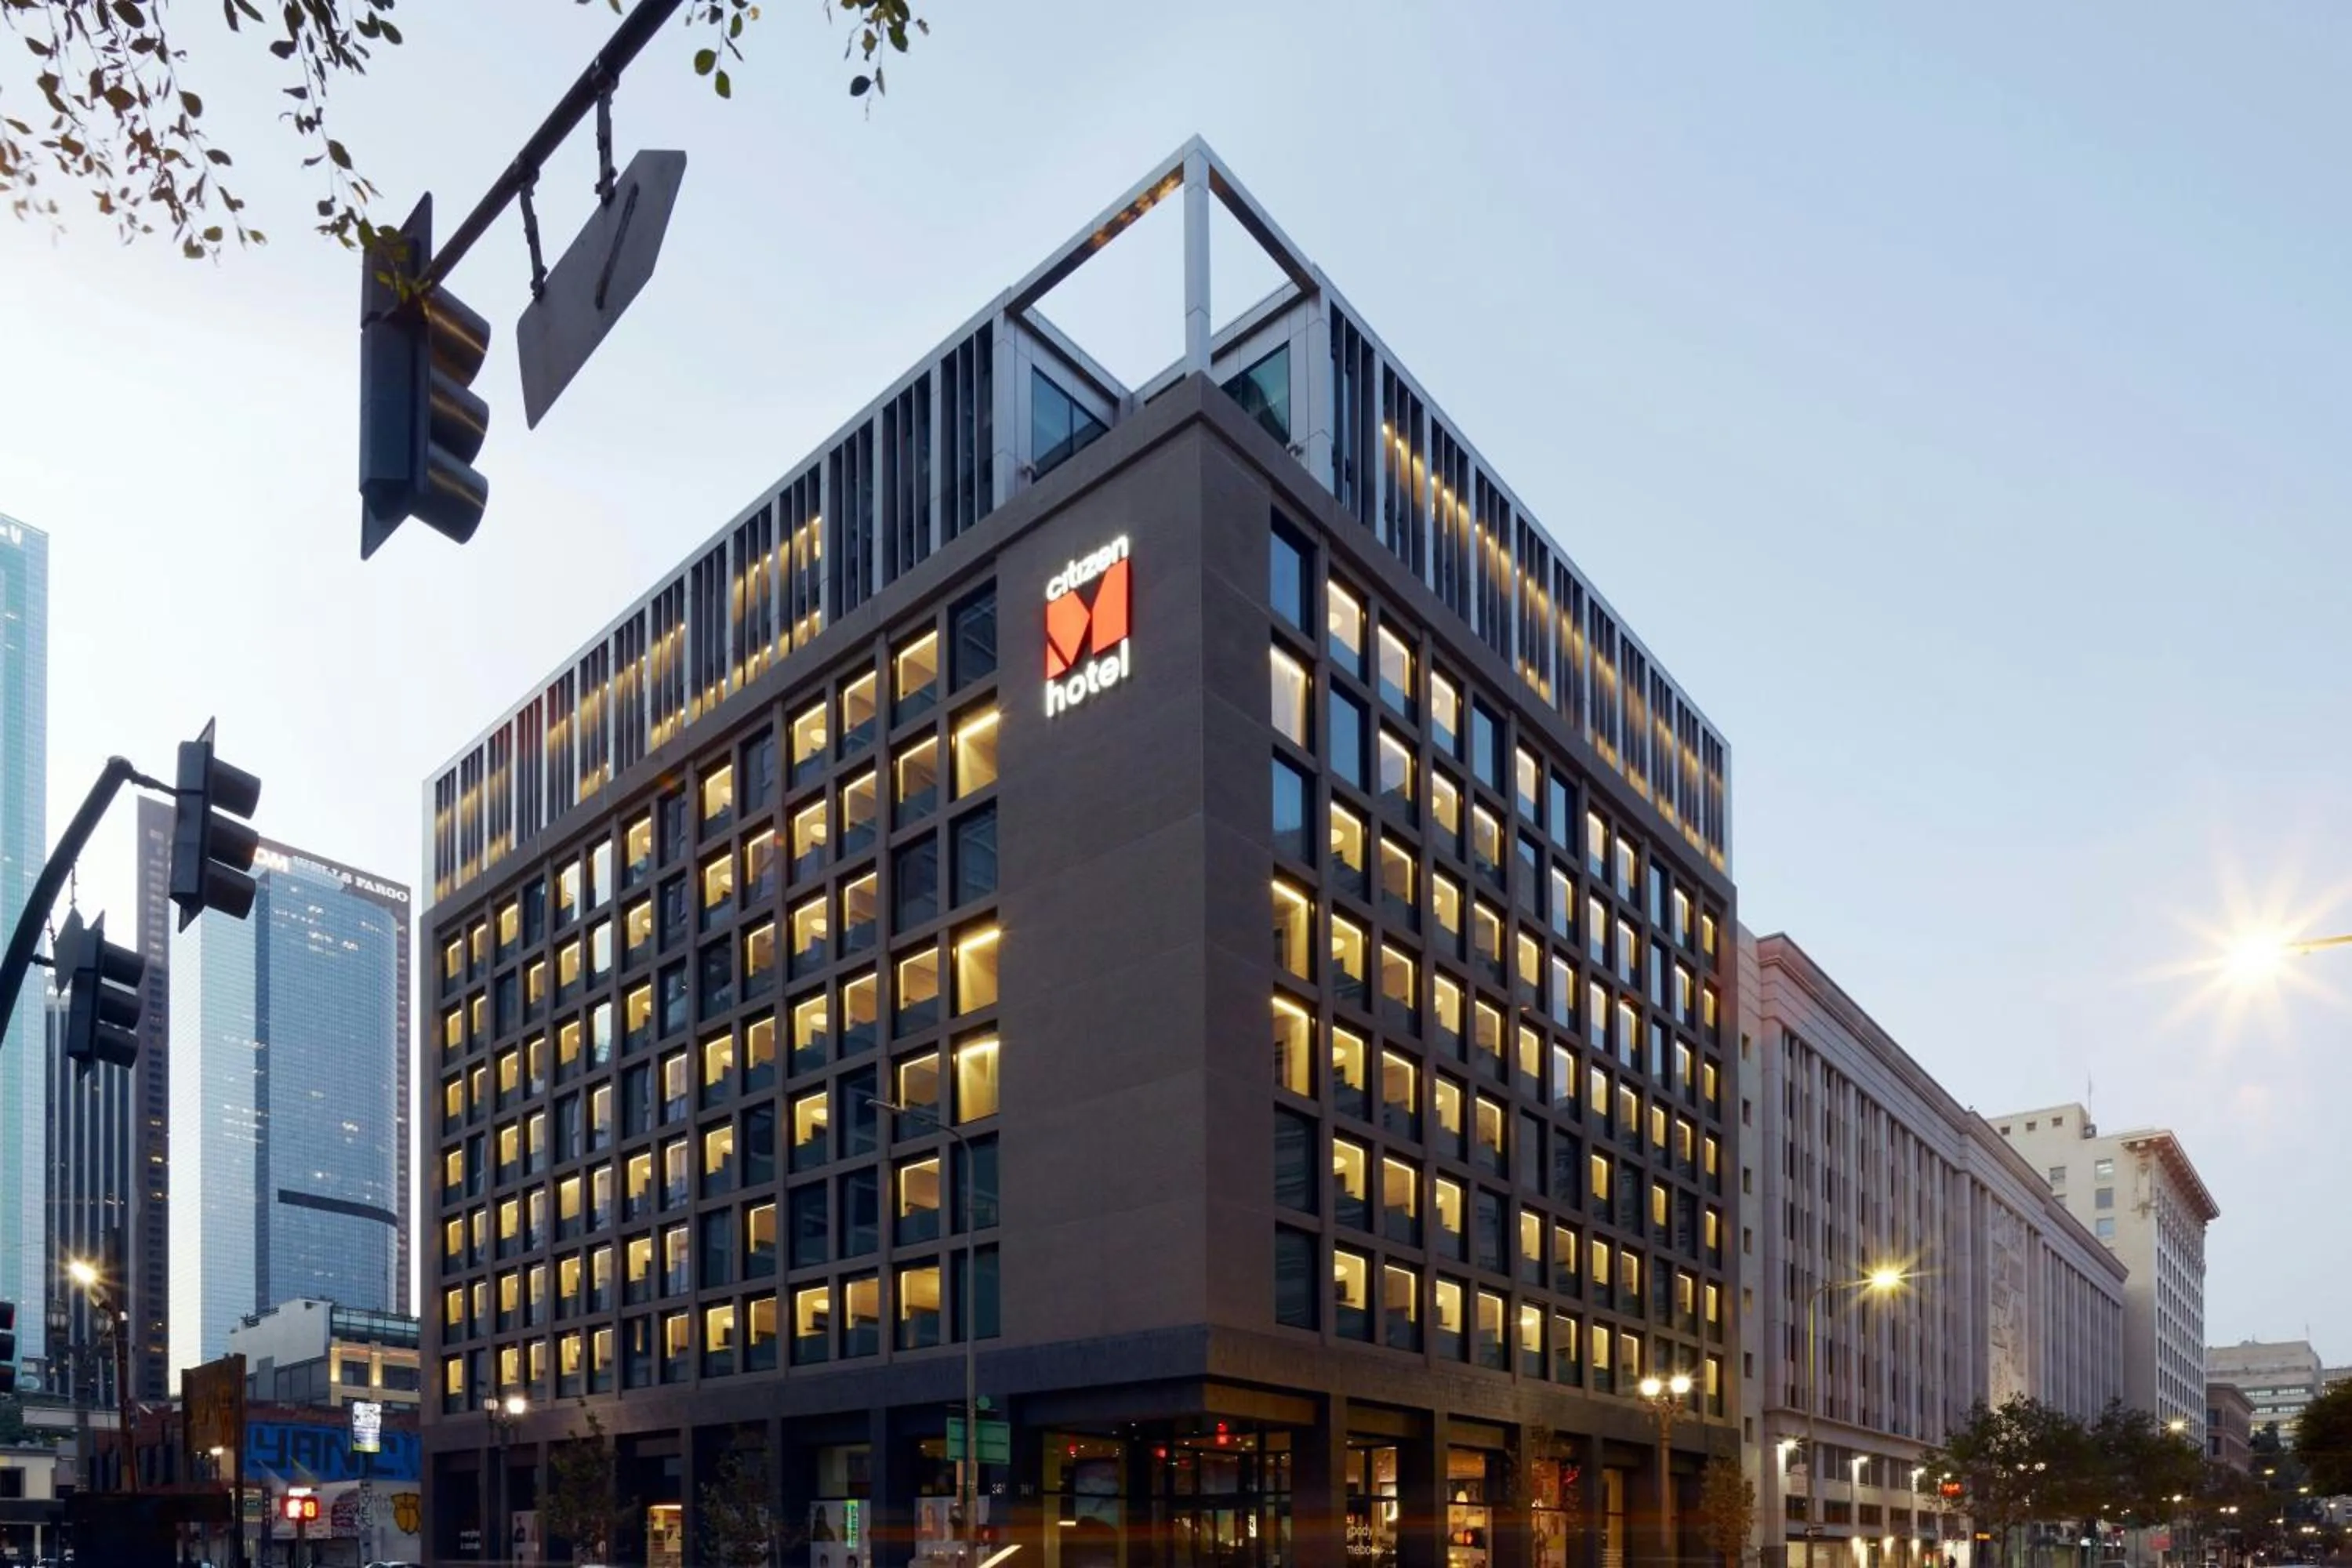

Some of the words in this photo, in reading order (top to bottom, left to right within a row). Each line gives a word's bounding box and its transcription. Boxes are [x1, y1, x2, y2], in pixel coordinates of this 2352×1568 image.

[1045, 534, 1130, 601] citizen
[1044, 637, 1130, 718] hotel
[355, 876, 408, 902] FARGO
